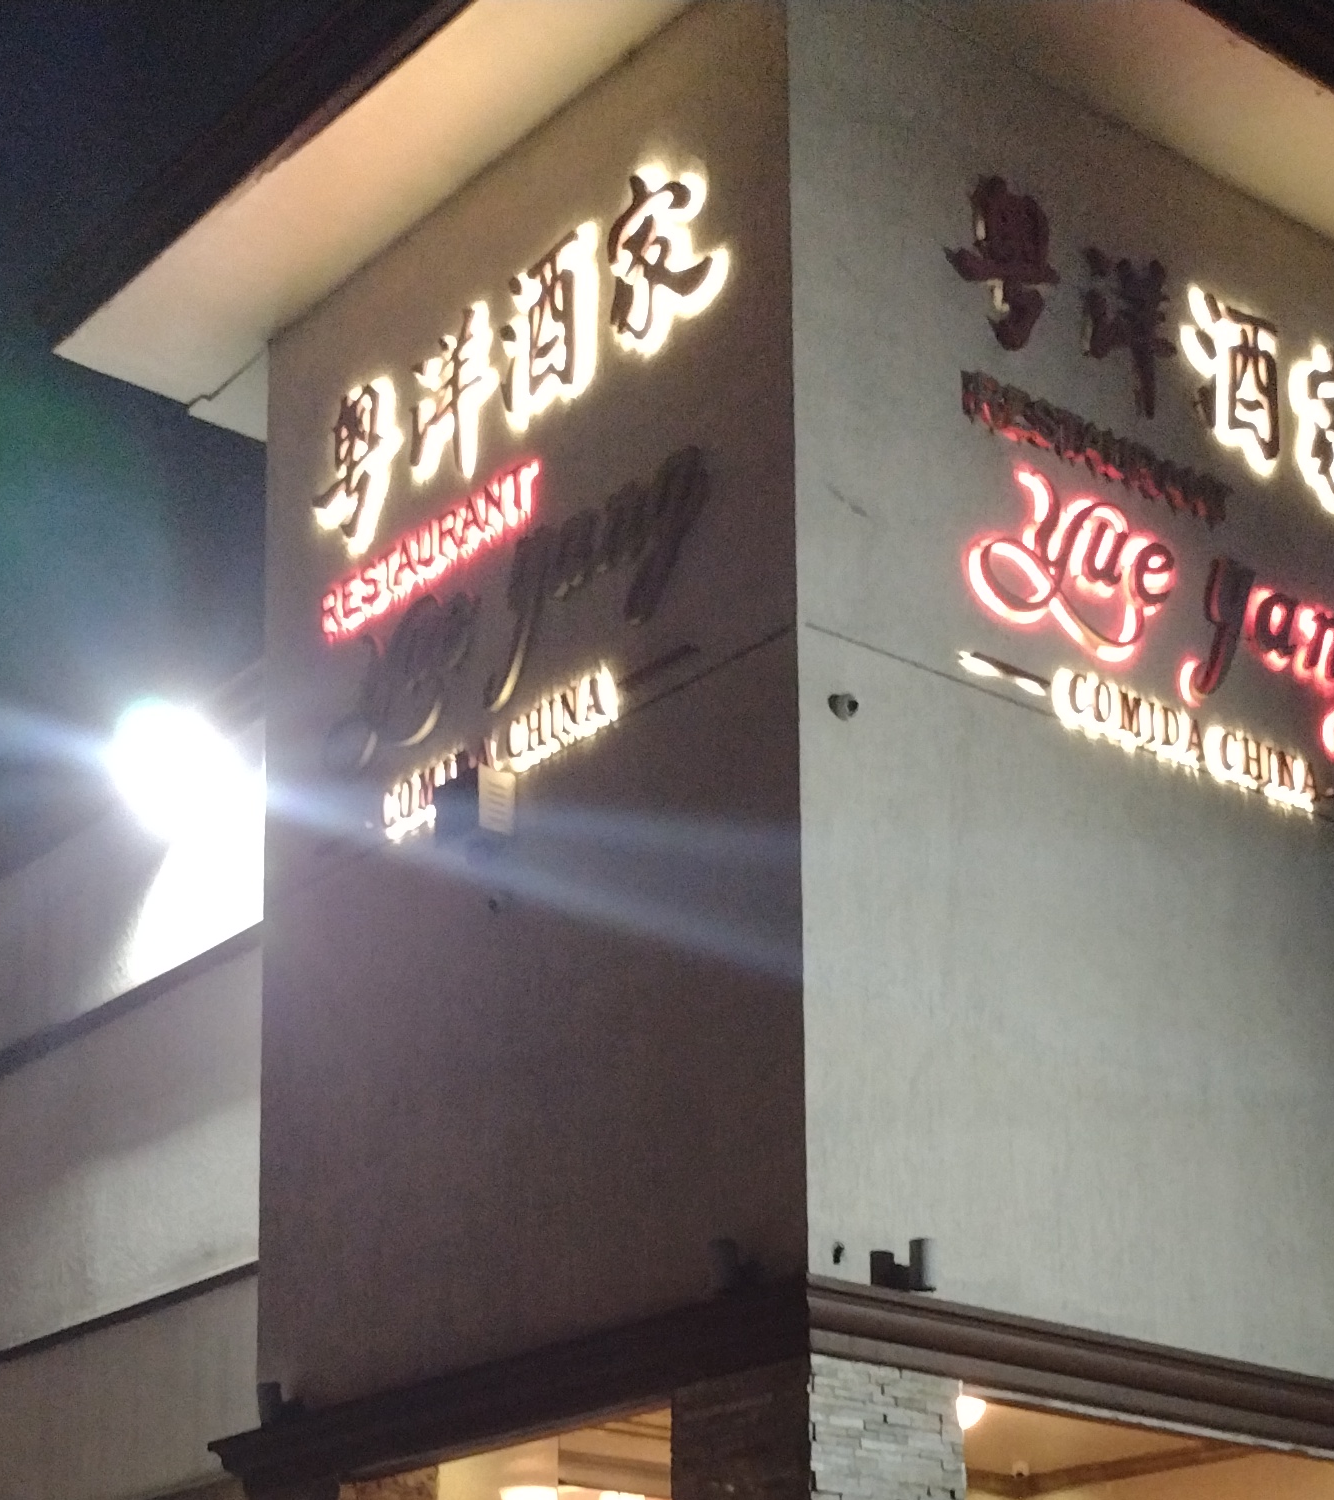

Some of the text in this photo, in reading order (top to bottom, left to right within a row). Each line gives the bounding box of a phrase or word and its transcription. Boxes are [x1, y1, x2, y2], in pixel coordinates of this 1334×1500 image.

[322, 460, 540, 642] RESTAURANT
[964, 467, 1177, 666] Yue
[507, 660, 619, 773] CHINA
[1052, 666, 1334, 812] COMIDA CHINA
